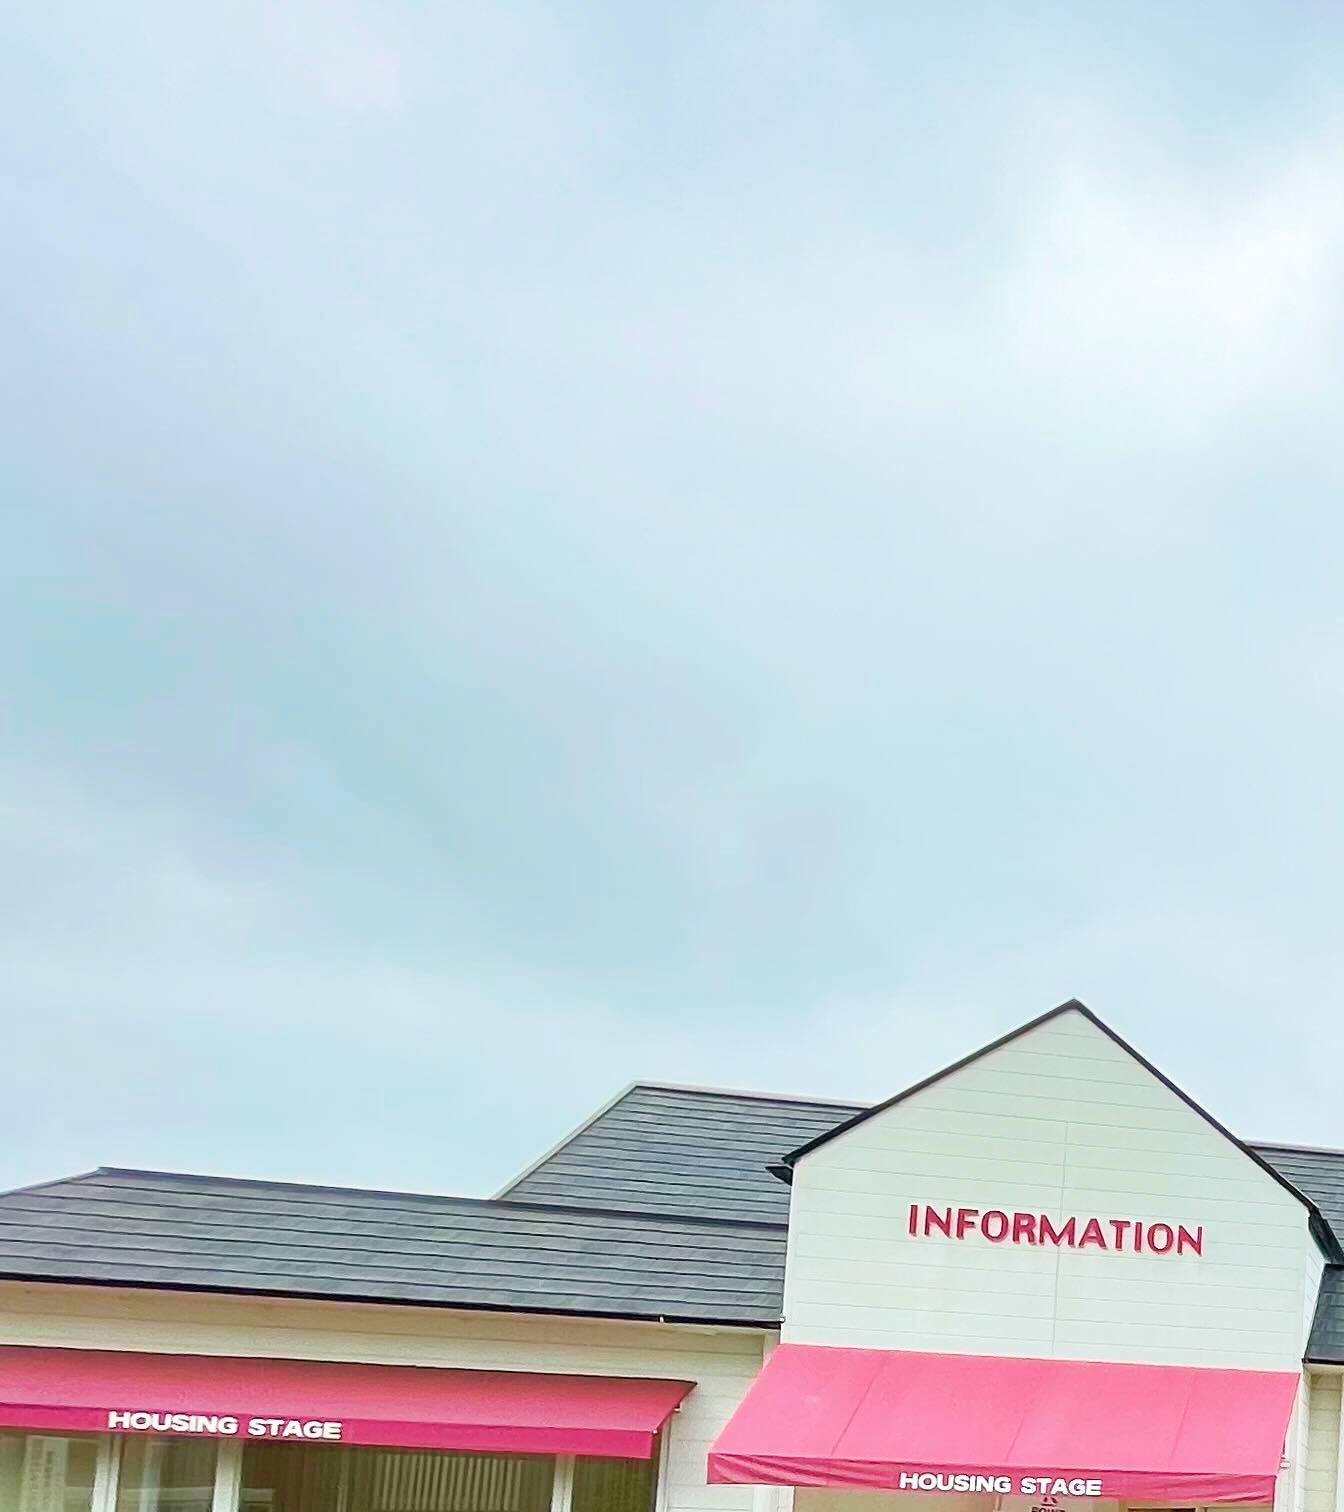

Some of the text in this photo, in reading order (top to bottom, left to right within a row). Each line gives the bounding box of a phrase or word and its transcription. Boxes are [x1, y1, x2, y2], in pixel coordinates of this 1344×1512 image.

[908, 1204, 1203, 1257] INFORMATION
[108, 1410, 342, 1440] HOUSING STAGE
[899, 1472, 1102, 1496] HOUSING STAGE
